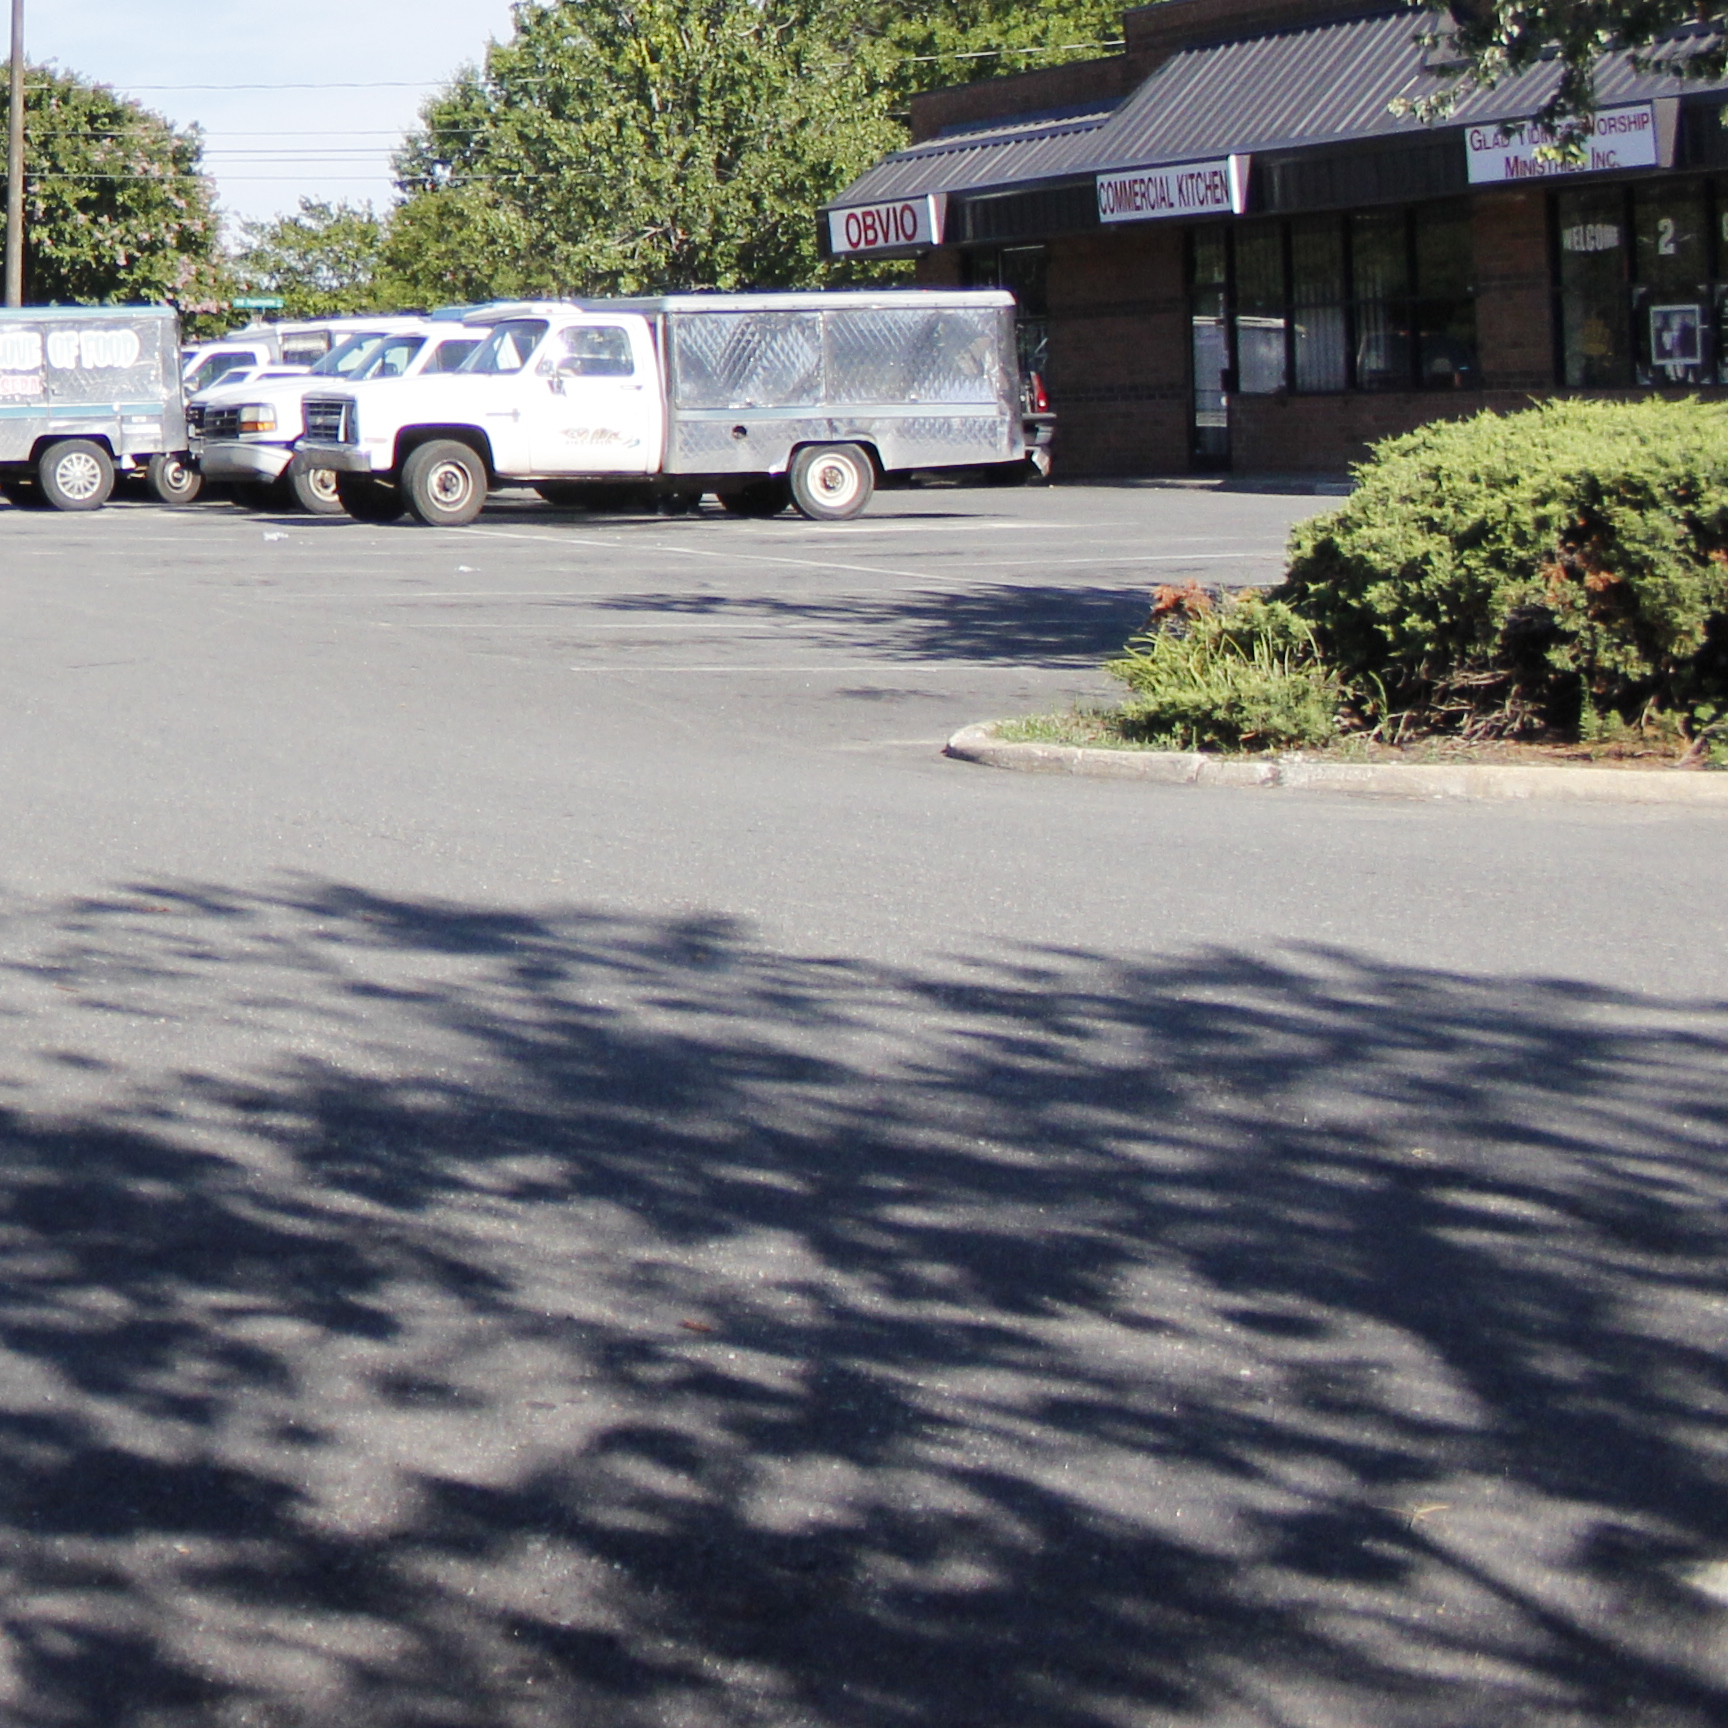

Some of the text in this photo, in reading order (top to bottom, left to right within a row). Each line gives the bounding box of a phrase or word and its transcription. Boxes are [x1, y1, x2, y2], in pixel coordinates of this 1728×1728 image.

[1580, 113, 1649, 137] ORSHIP
[1098, 170, 1230, 216] COMMERCIAL KITCHEN
[845, 203, 917, 250] OBVIO
[1562, 224, 1619, 252] WELCOME
[47, 331, 79, 369] OF
[79, 329, 140, 369] FOOD
